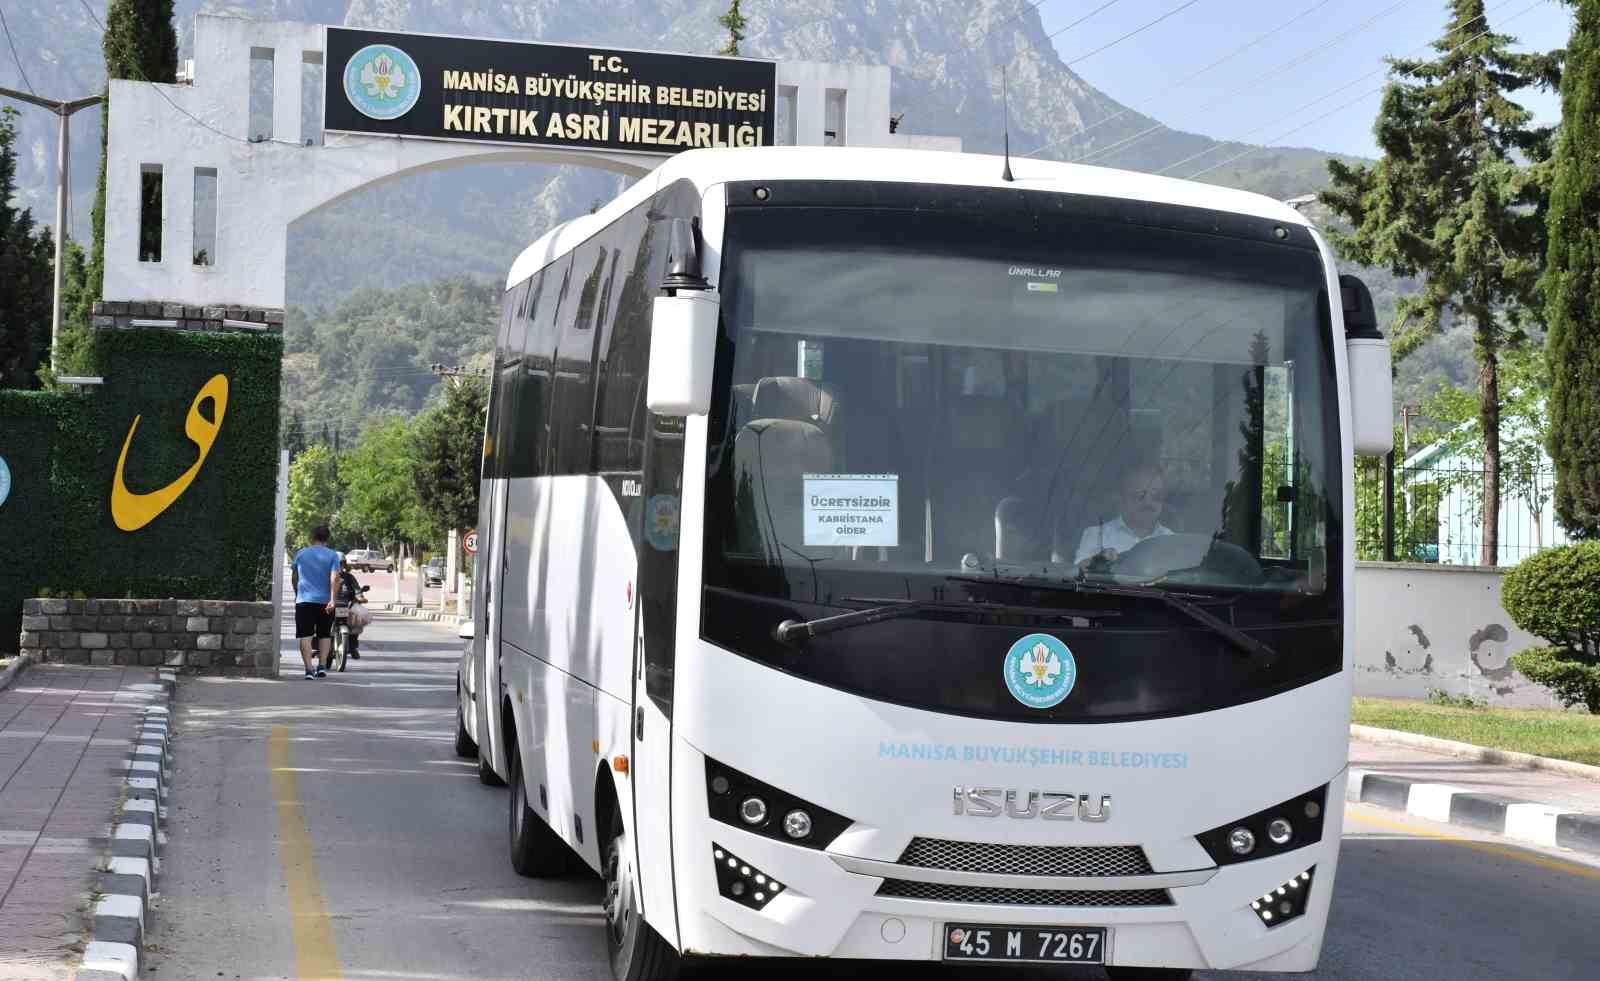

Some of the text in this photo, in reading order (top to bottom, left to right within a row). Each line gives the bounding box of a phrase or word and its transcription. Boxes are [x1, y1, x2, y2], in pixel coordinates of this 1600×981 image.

[589, 55, 629, 74] T.C.
[443, 68, 520, 94] MANİSA
[525, 73, 651, 105] BÜYÜKŞEHİR
[656, 85, 766, 112] BELEDİYESİ
[443, 104, 763, 148] KIRTIK ASRİ MEZARLIĞI
[811, 495, 891, 508] ÜCRETSİZDİR
[818, 512, 884, 524] KABRİSTANA
[836, 525, 867, 535] GİDER
[953, 785, 1113, 824] ISUZU
[960, 929, 1100, 959] 45 M 7267
